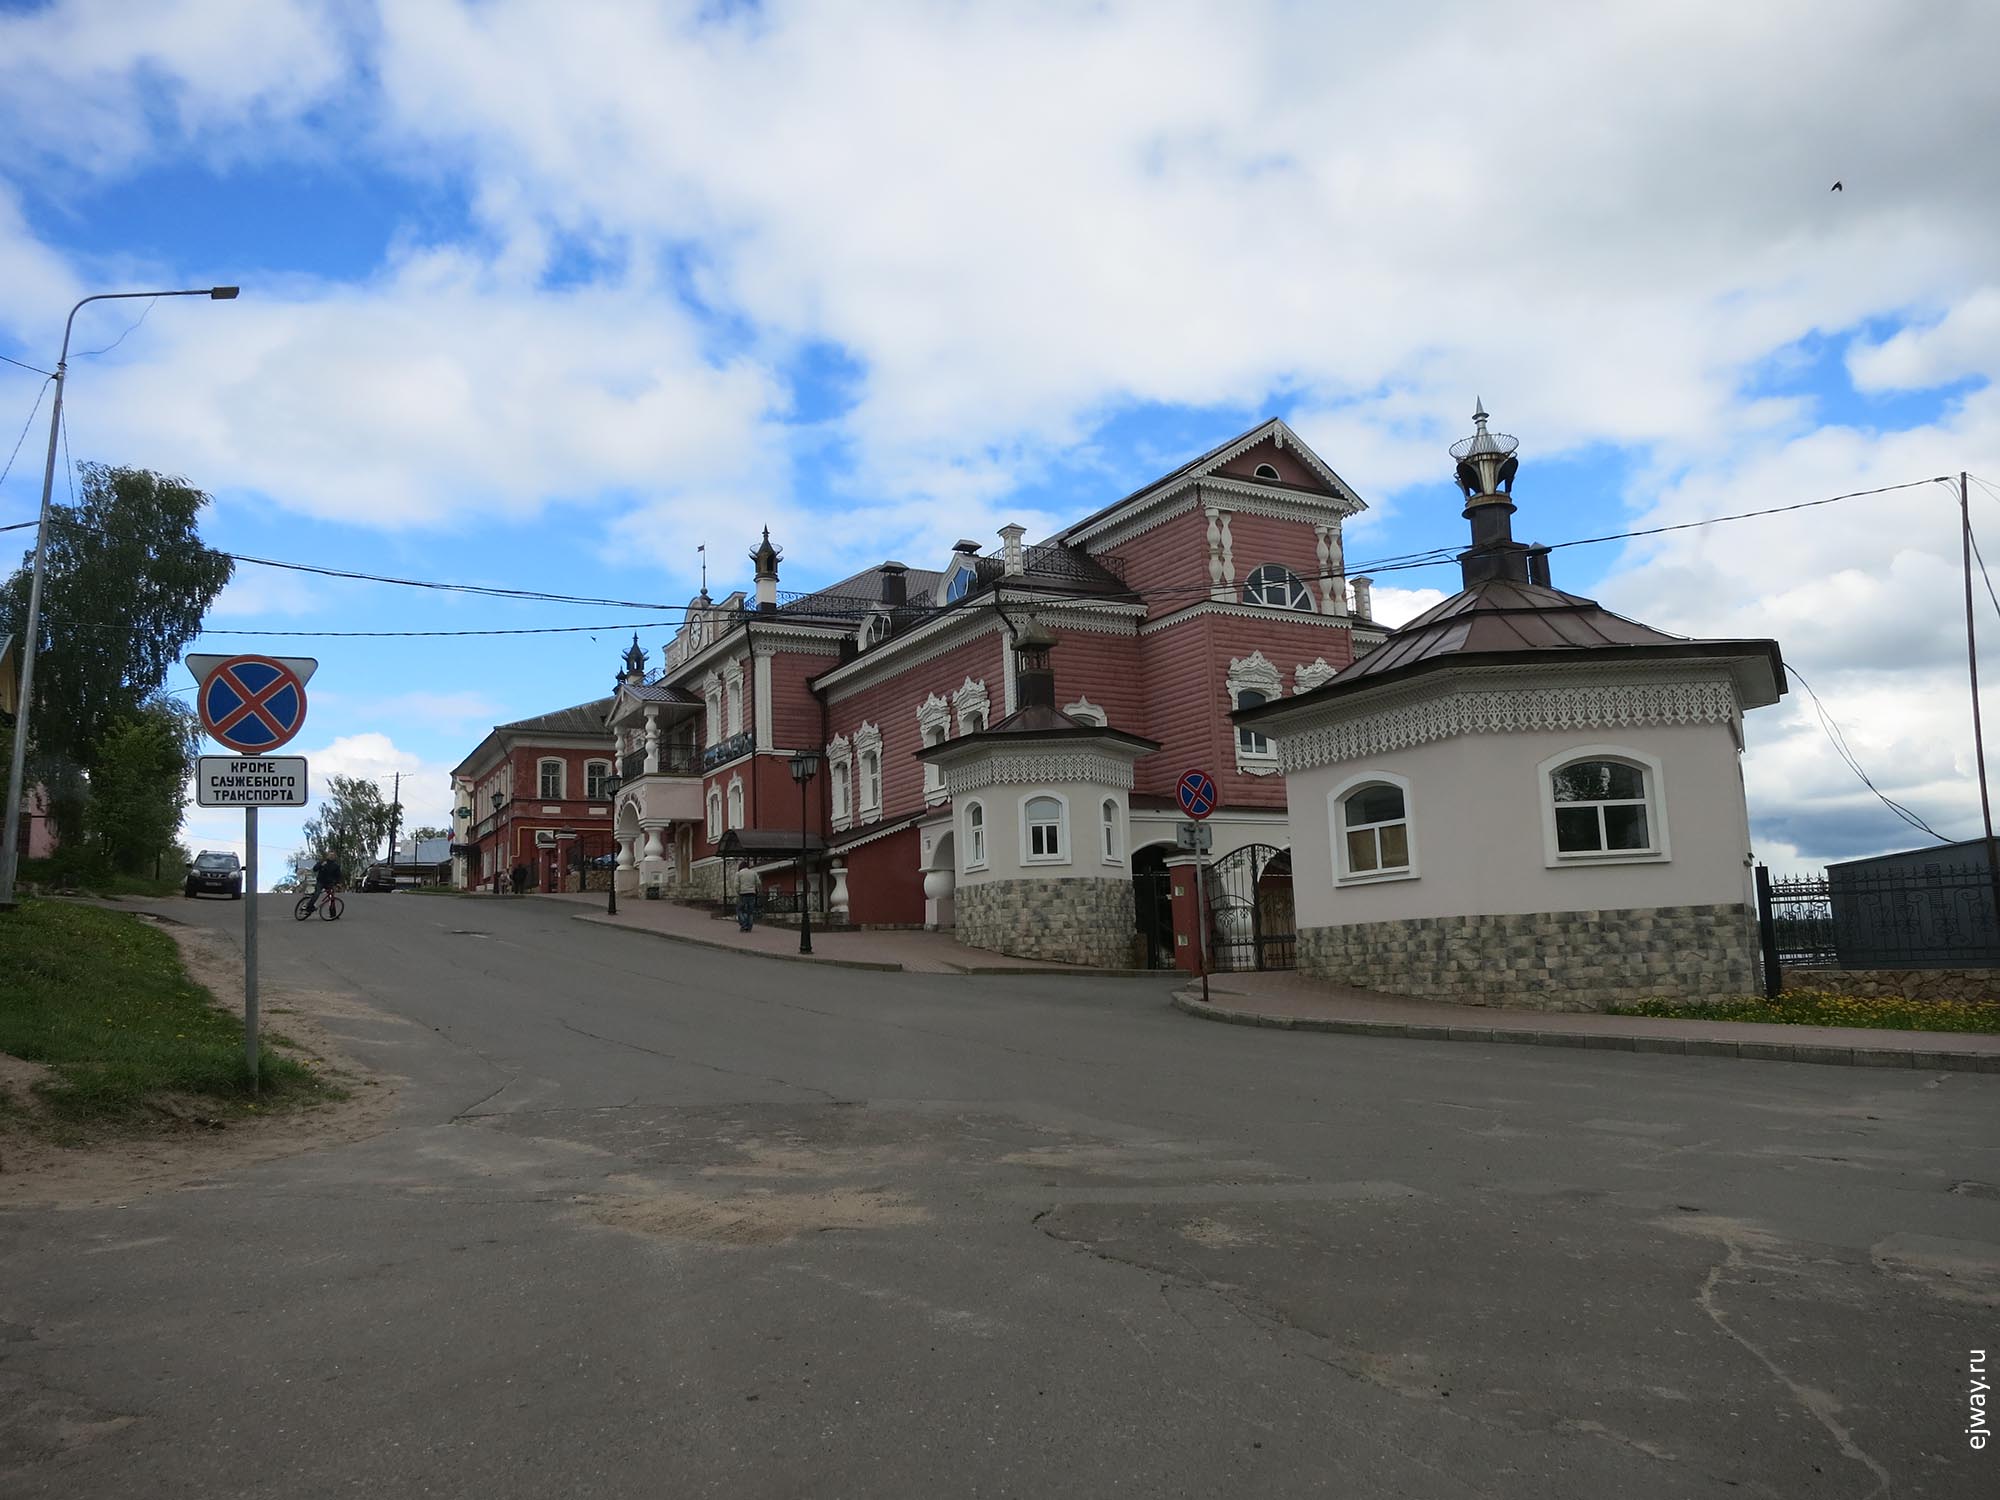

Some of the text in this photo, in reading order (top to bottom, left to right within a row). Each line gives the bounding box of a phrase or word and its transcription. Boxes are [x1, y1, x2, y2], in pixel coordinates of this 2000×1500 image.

[231, 762, 275, 773] КРОМЕ
[211, 776, 295, 787] СЛУЖЕБНОГО
[213, 789, 294, 801] ТРАНСПОРТА
